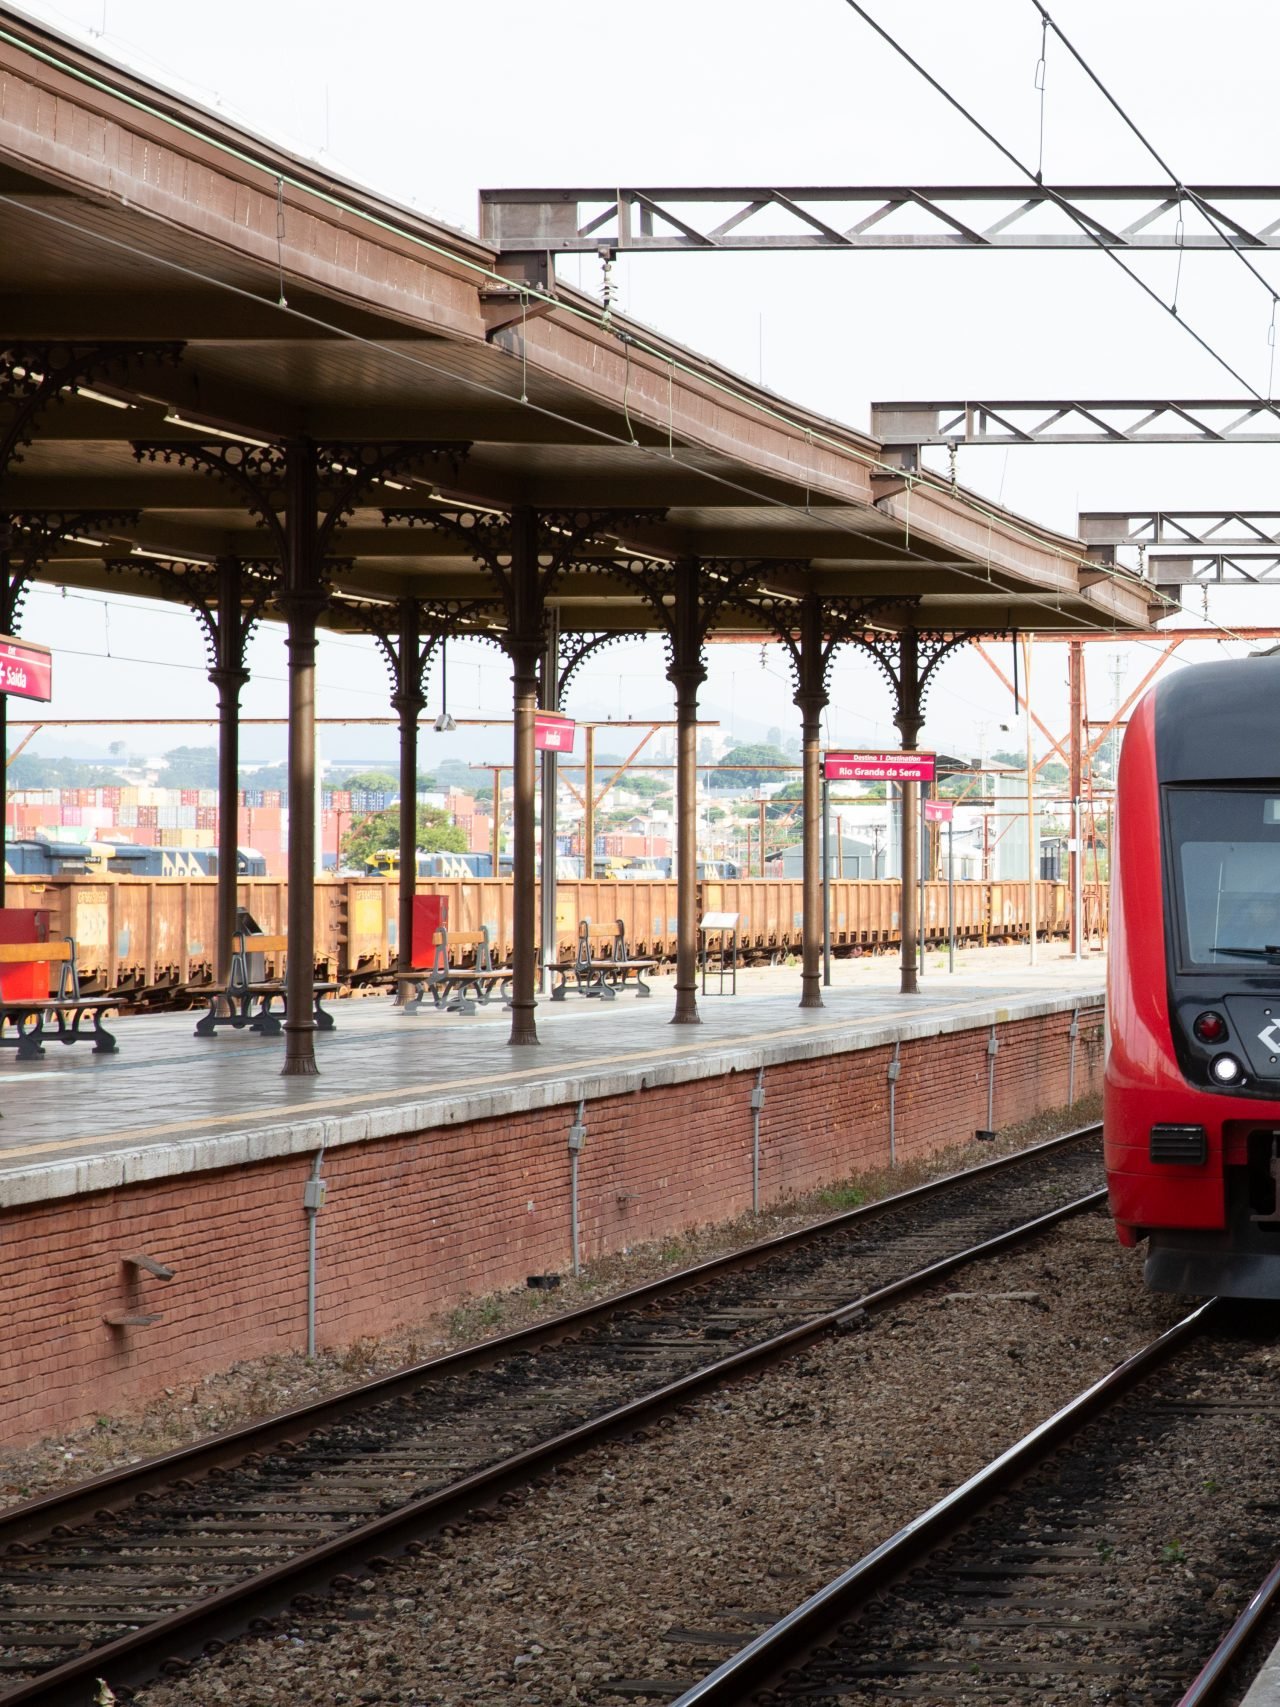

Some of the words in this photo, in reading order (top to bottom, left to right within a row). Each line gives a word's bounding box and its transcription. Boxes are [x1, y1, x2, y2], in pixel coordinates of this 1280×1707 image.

[6, 666, 27, 688] Saída
[838, 767, 853, 776] Rio
[854, 767, 885, 776] Grande
[886, 768, 897, 776] da
[898, 768, 921, 777] Serra
